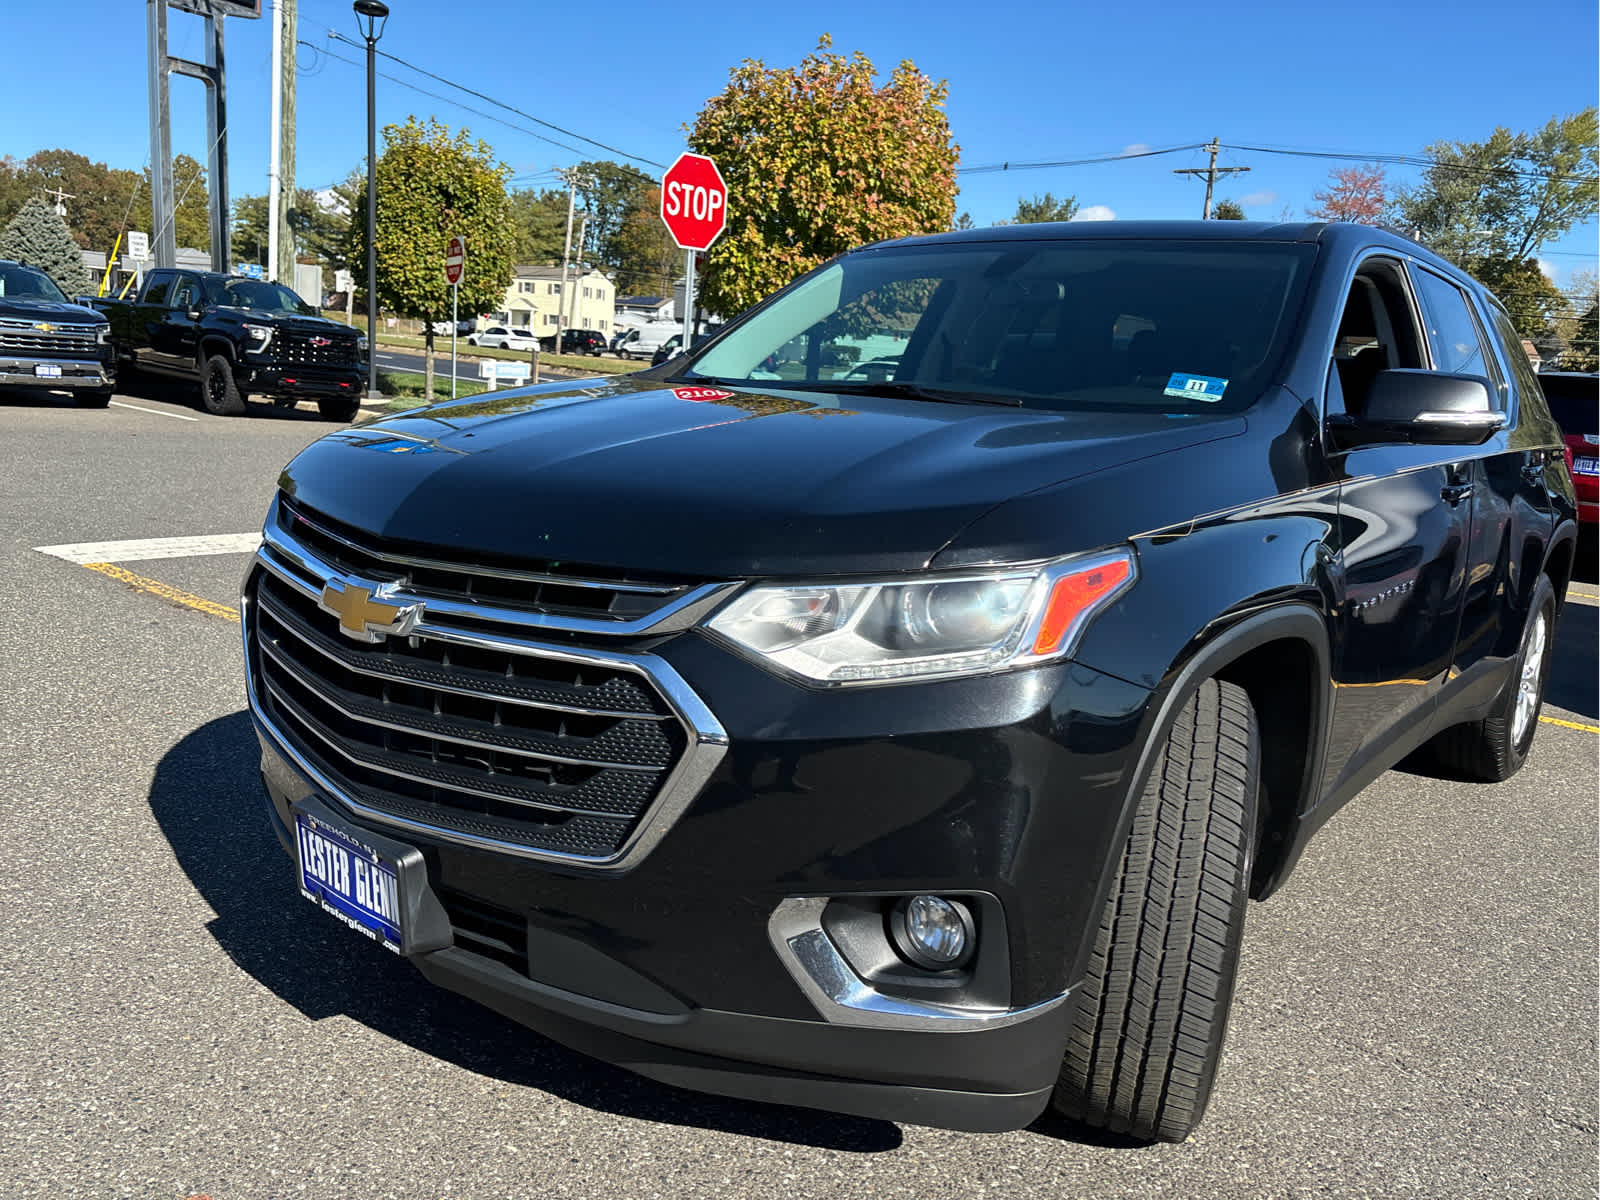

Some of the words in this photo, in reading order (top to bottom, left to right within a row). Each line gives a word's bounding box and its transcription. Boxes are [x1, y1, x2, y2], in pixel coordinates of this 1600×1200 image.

[666, 181, 722, 222] STOP
[301, 827, 350, 897] LESTER
[354, 856, 400, 926] GLENN
